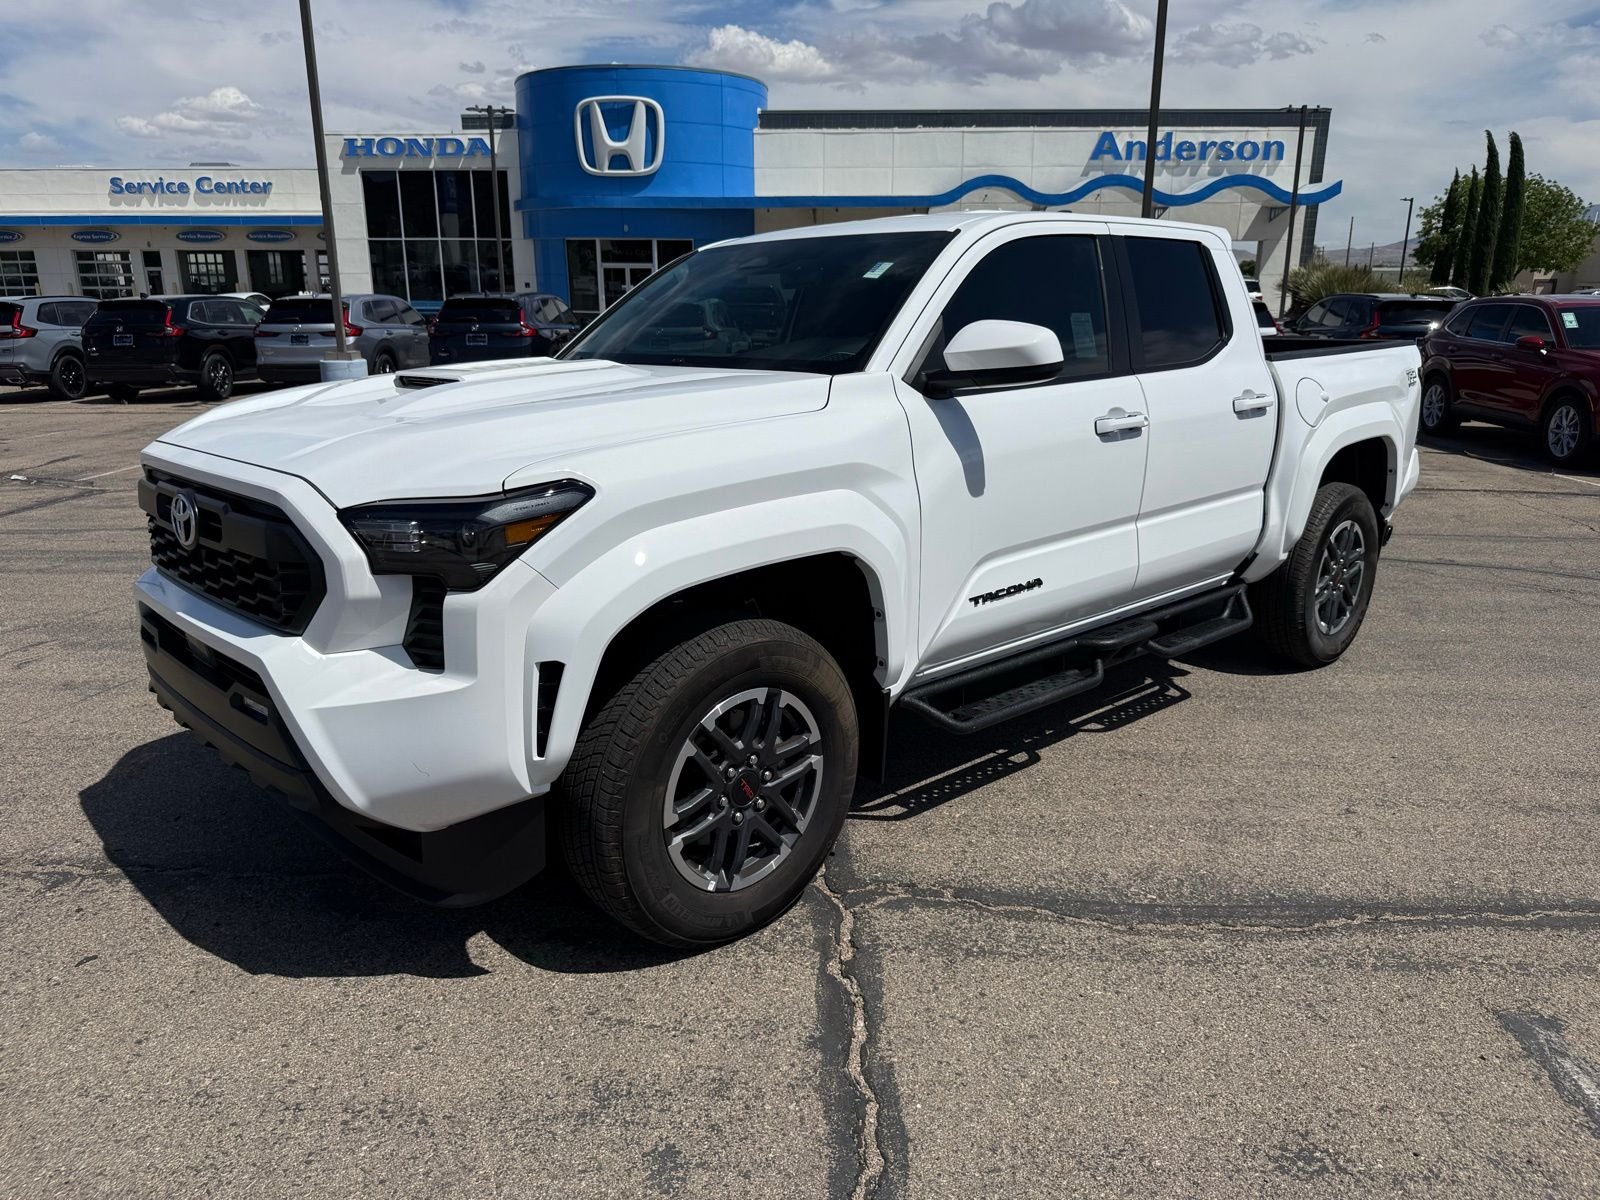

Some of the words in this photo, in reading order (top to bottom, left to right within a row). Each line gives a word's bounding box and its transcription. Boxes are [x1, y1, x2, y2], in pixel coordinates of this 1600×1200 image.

[343, 137, 491, 157] HONDA
[1089, 131, 1285, 161] Anderson
[109, 176, 190, 194] Service
[195, 176, 273, 194] Center
[968, 578, 1043, 606] TACOMA
[739, 777, 753, 800] TRD
